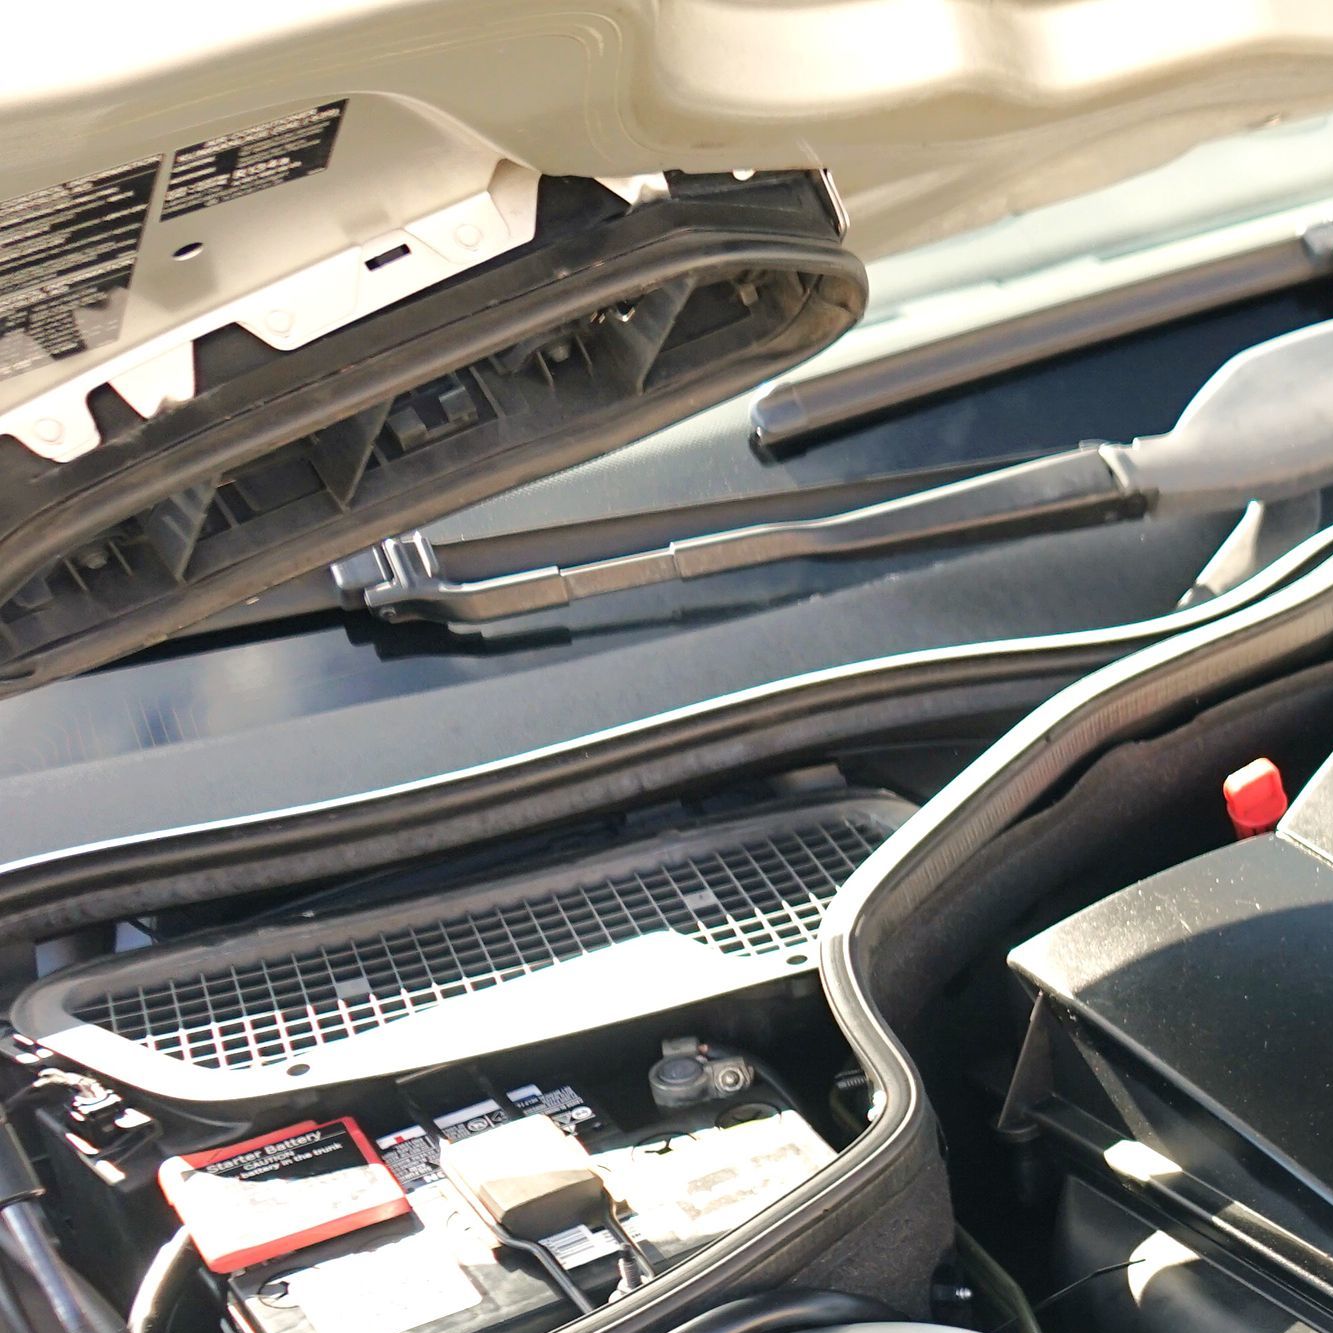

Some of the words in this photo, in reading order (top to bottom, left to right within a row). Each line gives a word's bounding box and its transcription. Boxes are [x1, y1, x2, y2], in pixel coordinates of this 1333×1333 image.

[206, 1151, 263, 1175] Starter
[265, 1131, 322, 1156] Battery
[243, 1151, 295, 1172] CAUTION
[282, 1157, 292, 1168] in
[293, 1152, 312, 1164] the
[313, 1143, 342, 1157] trunk
